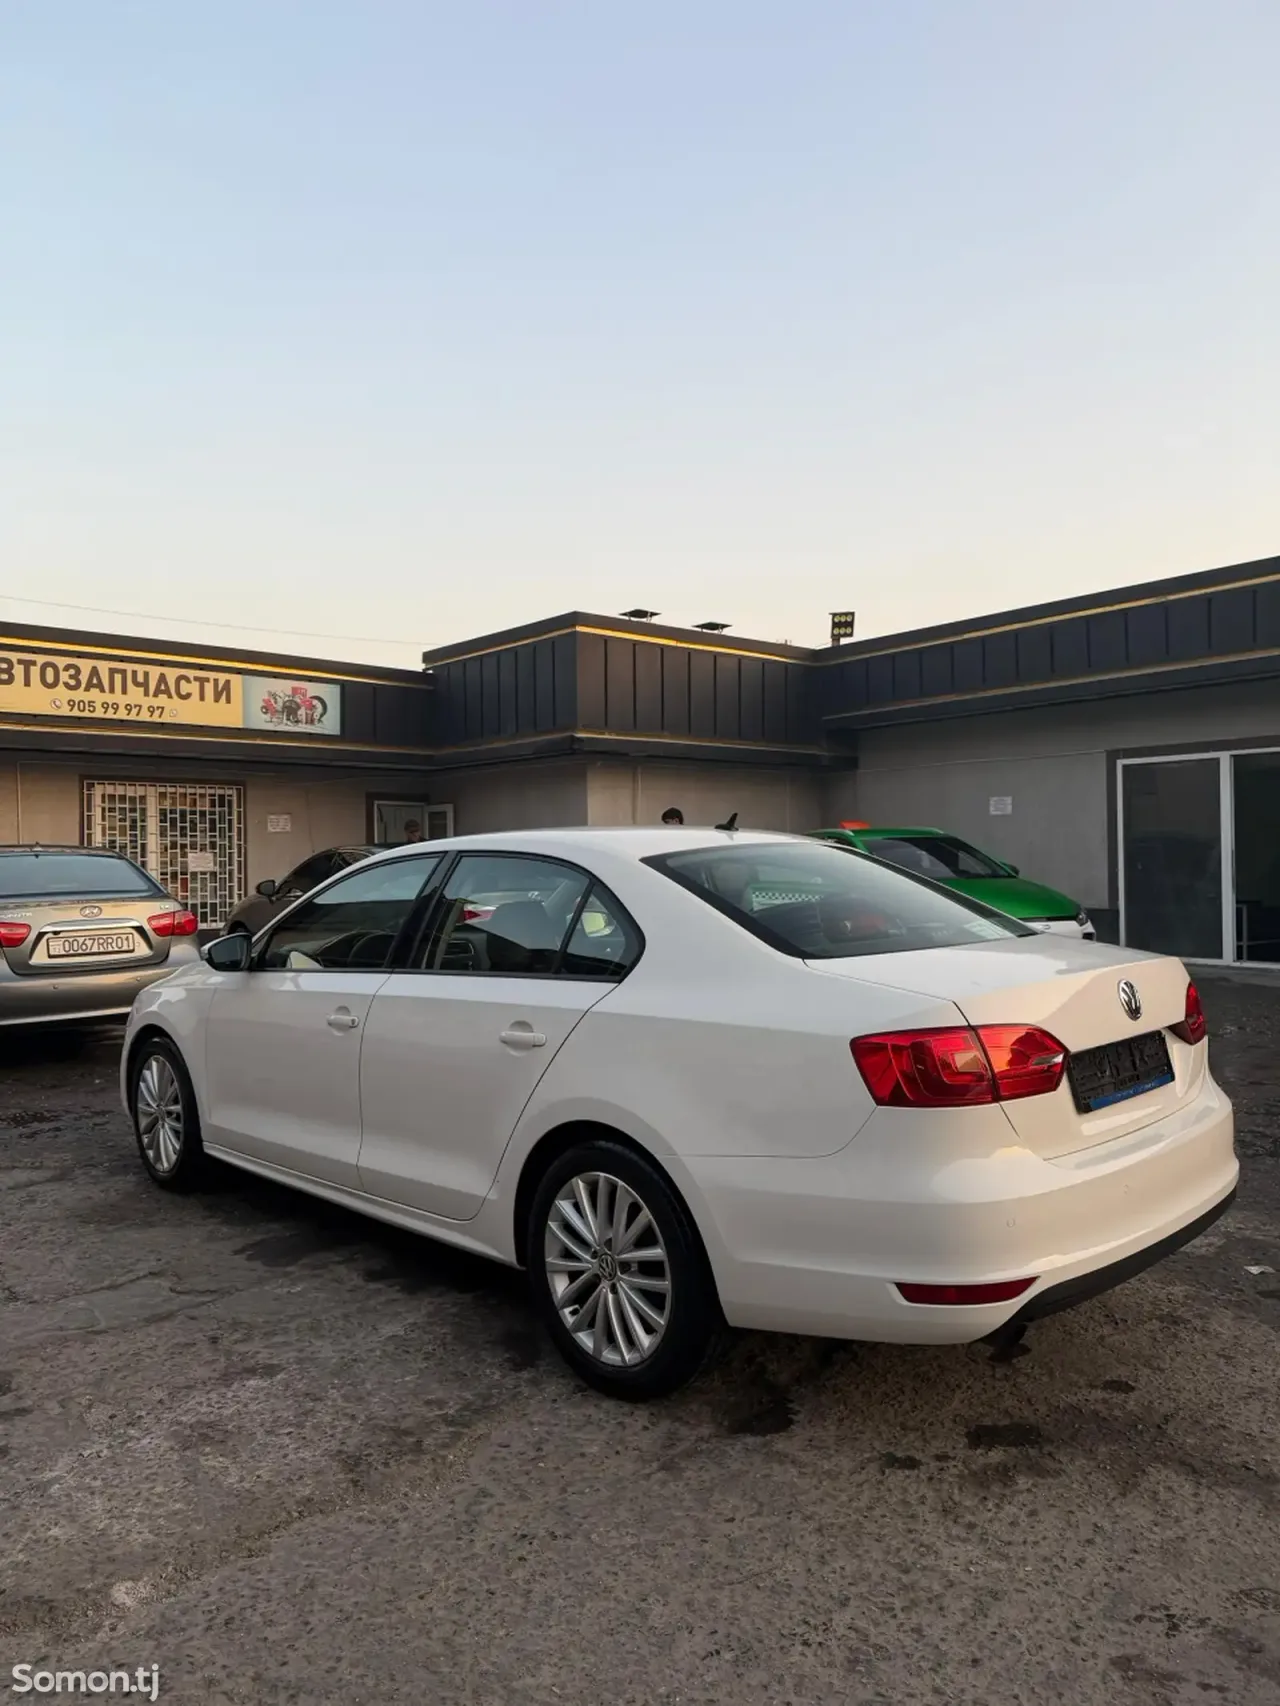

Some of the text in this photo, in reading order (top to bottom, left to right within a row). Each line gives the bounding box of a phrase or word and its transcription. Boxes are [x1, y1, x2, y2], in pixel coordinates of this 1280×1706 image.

[0, 657, 232, 704] ВТОЗАПЧАСТИ
[67, 699, 165, 718] 905 99 97 97
